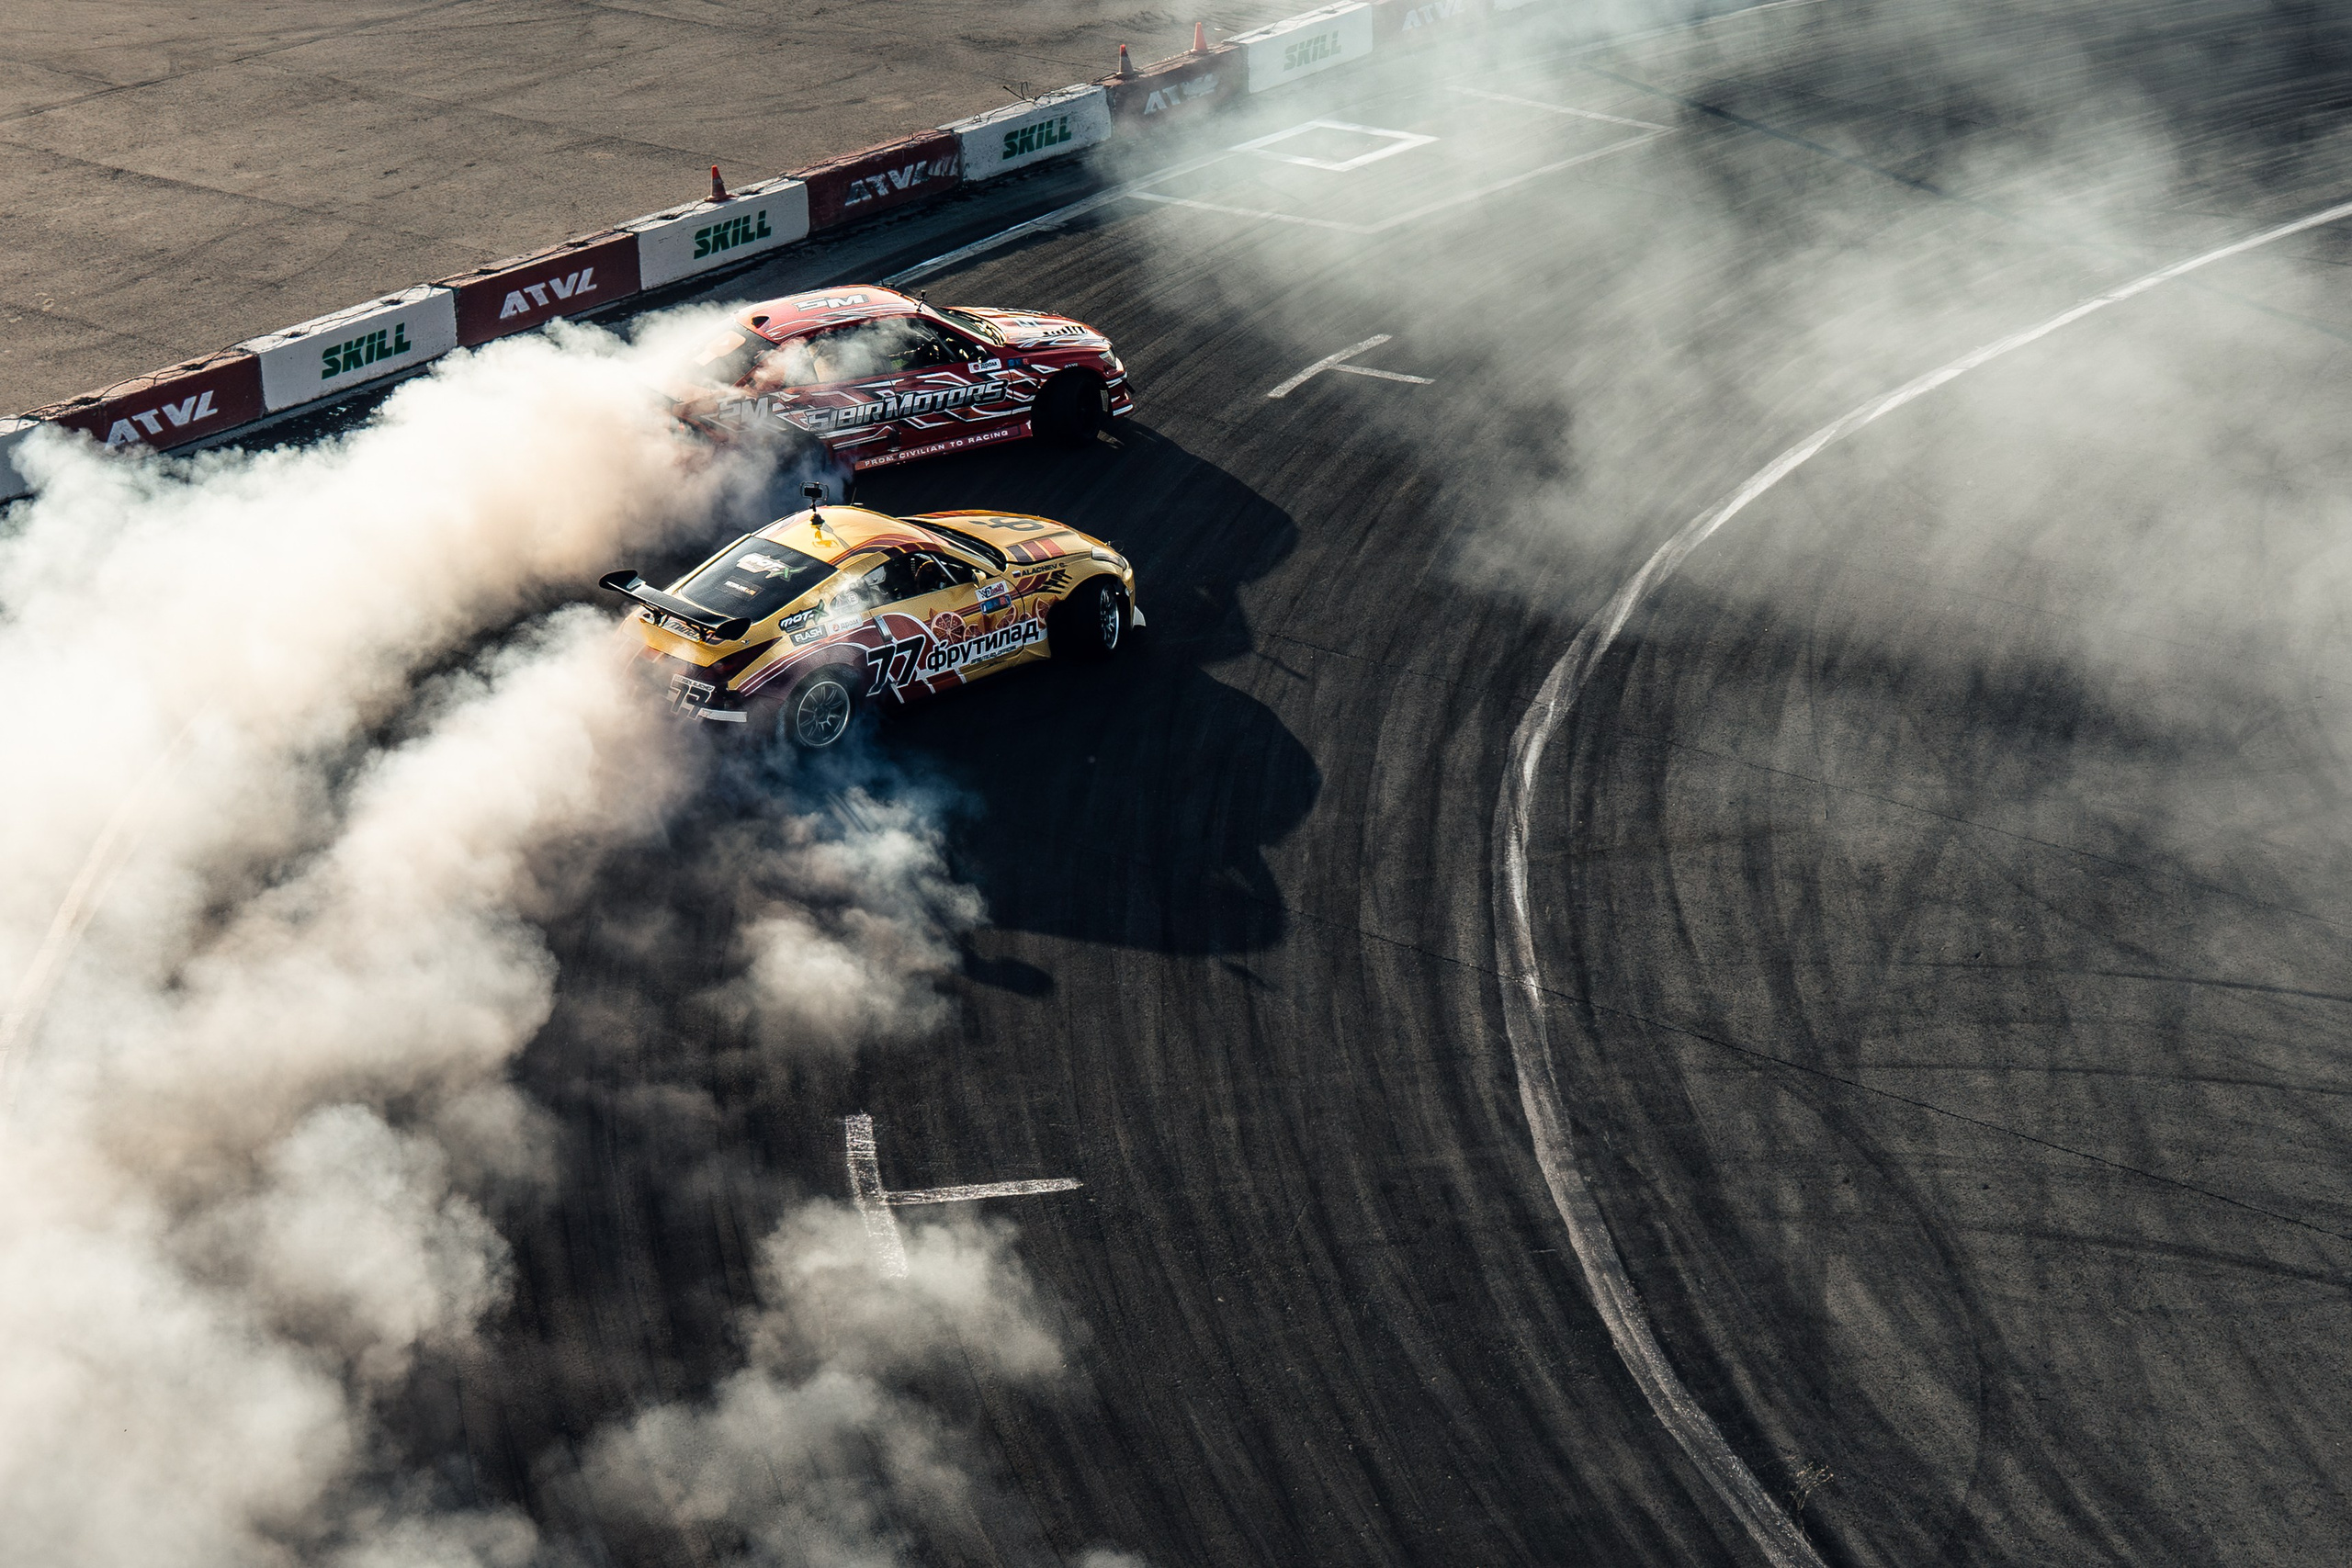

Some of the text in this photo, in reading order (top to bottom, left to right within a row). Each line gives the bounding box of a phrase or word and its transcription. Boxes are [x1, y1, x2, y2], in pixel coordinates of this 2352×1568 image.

[1283, 29, 1341, 72] SKILL
[1002, 116, 1071, 160] SKILL
[694, 210, 771, 260] SKILL
[500, 267, 597, 319] ATVL
[322, 322, 412, 380] SKILL
[105, 389, 219, 451] ATVL
[899, 444, 945, 458] CIVILIAN
[968, 430, 1009, 444] RACING
[795, 627, 823, 643] FLASH
[866, 634, 926, 696] 77
